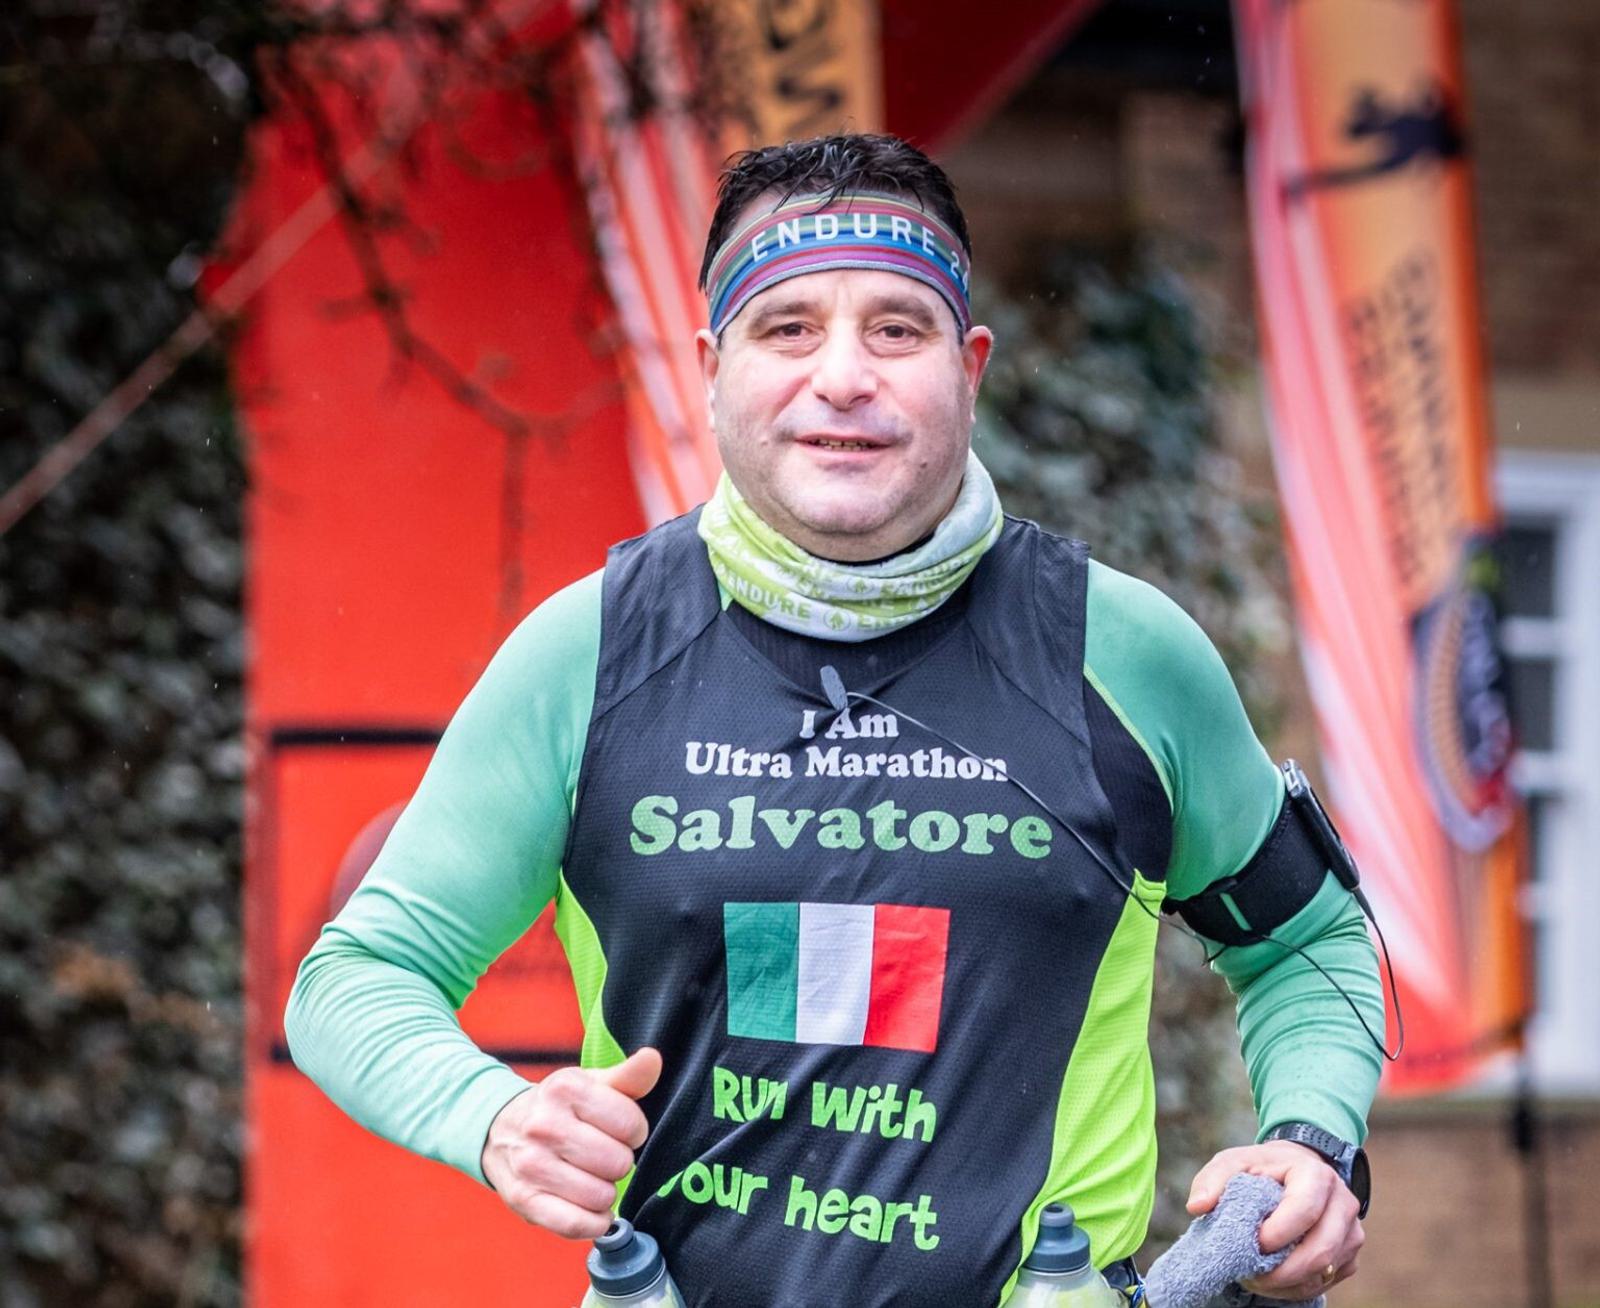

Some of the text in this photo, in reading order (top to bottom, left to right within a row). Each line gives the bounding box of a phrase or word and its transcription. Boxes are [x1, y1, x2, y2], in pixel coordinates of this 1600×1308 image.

[751, 213, 936, 262] ENDURE
[726, 574, 812, 621] ENDURE
[799, 707, 900, 739] I Am
[684, 741, 1009, 782] Ultra Marathon
[629, 794, 1054, 859] Salvatore
[712, 1065, 789, 1123] Run
[783, 1174, 941, 1251] heart
